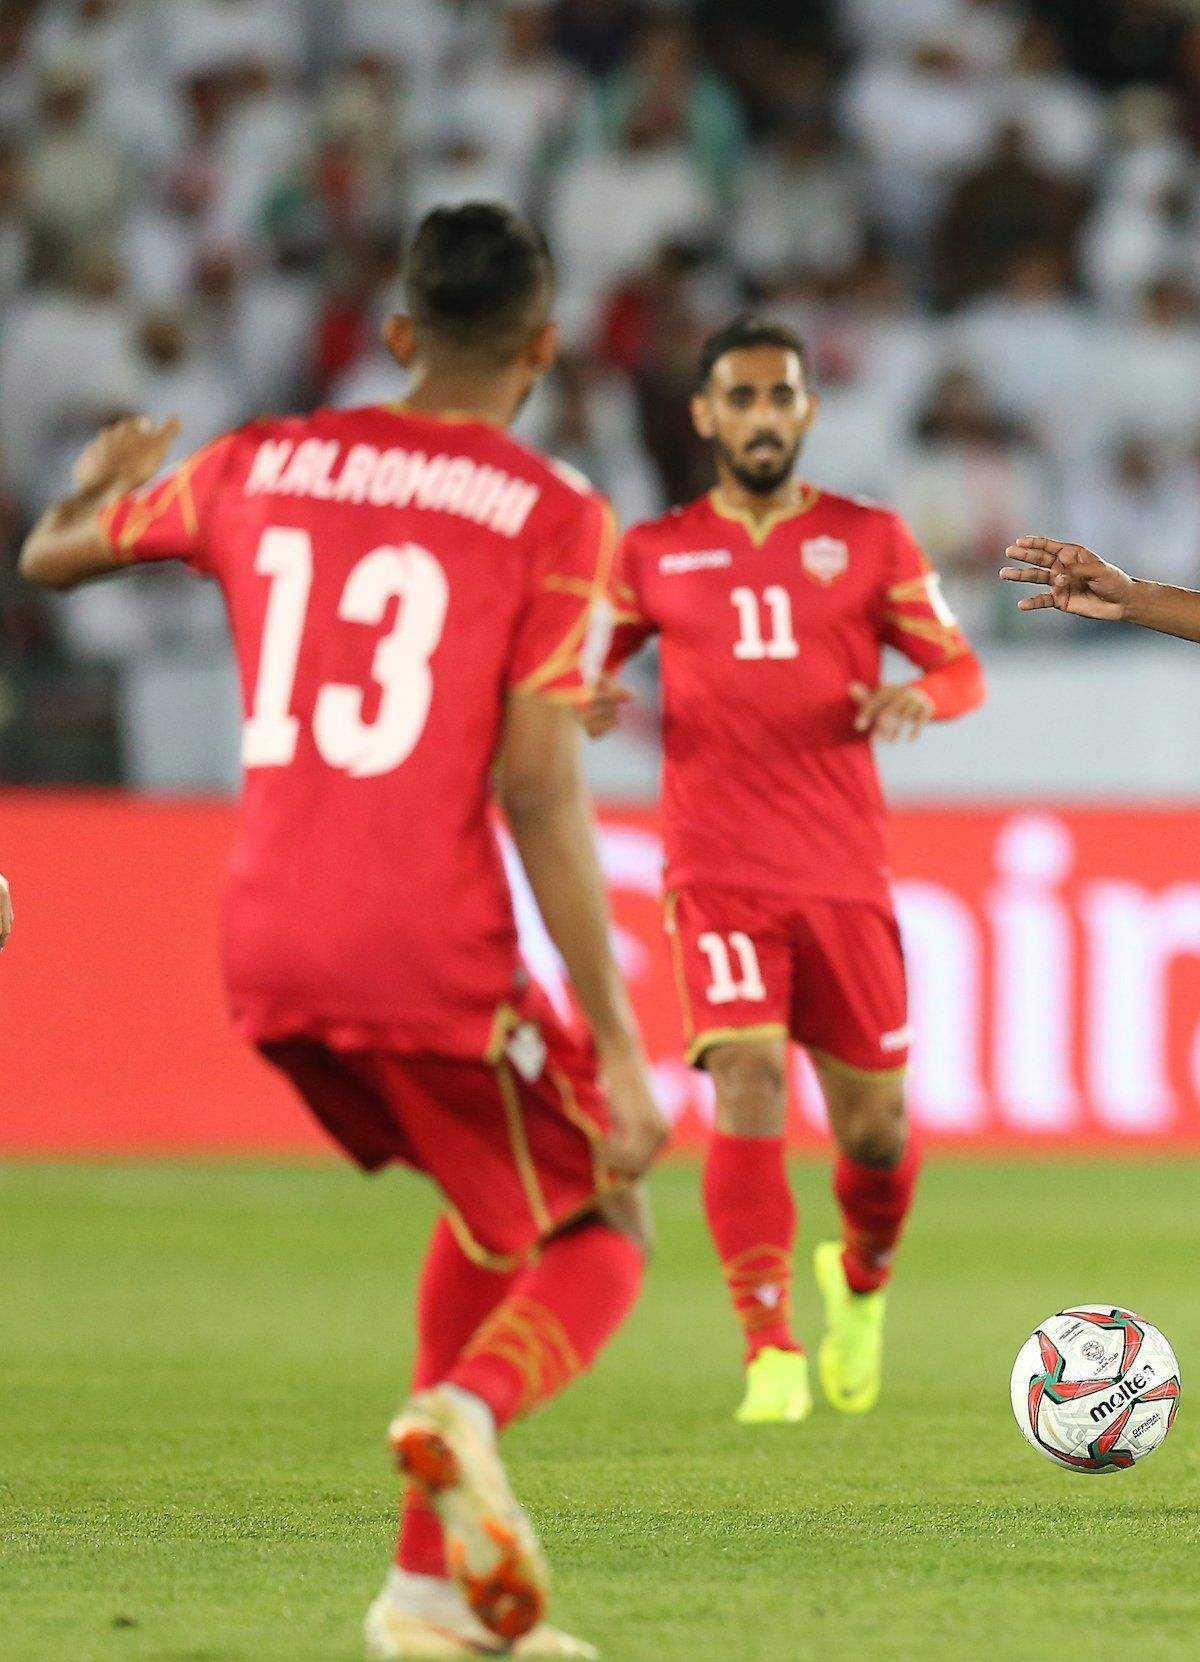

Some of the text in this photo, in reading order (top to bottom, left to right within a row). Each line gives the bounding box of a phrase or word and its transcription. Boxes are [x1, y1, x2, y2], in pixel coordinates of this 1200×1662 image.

[242, 526, 451, 778] 13
[729, 585, 800, 661] 11
[697, 930, 767, 1004] 11
[1090, 1364, 1156, 1423] molten
